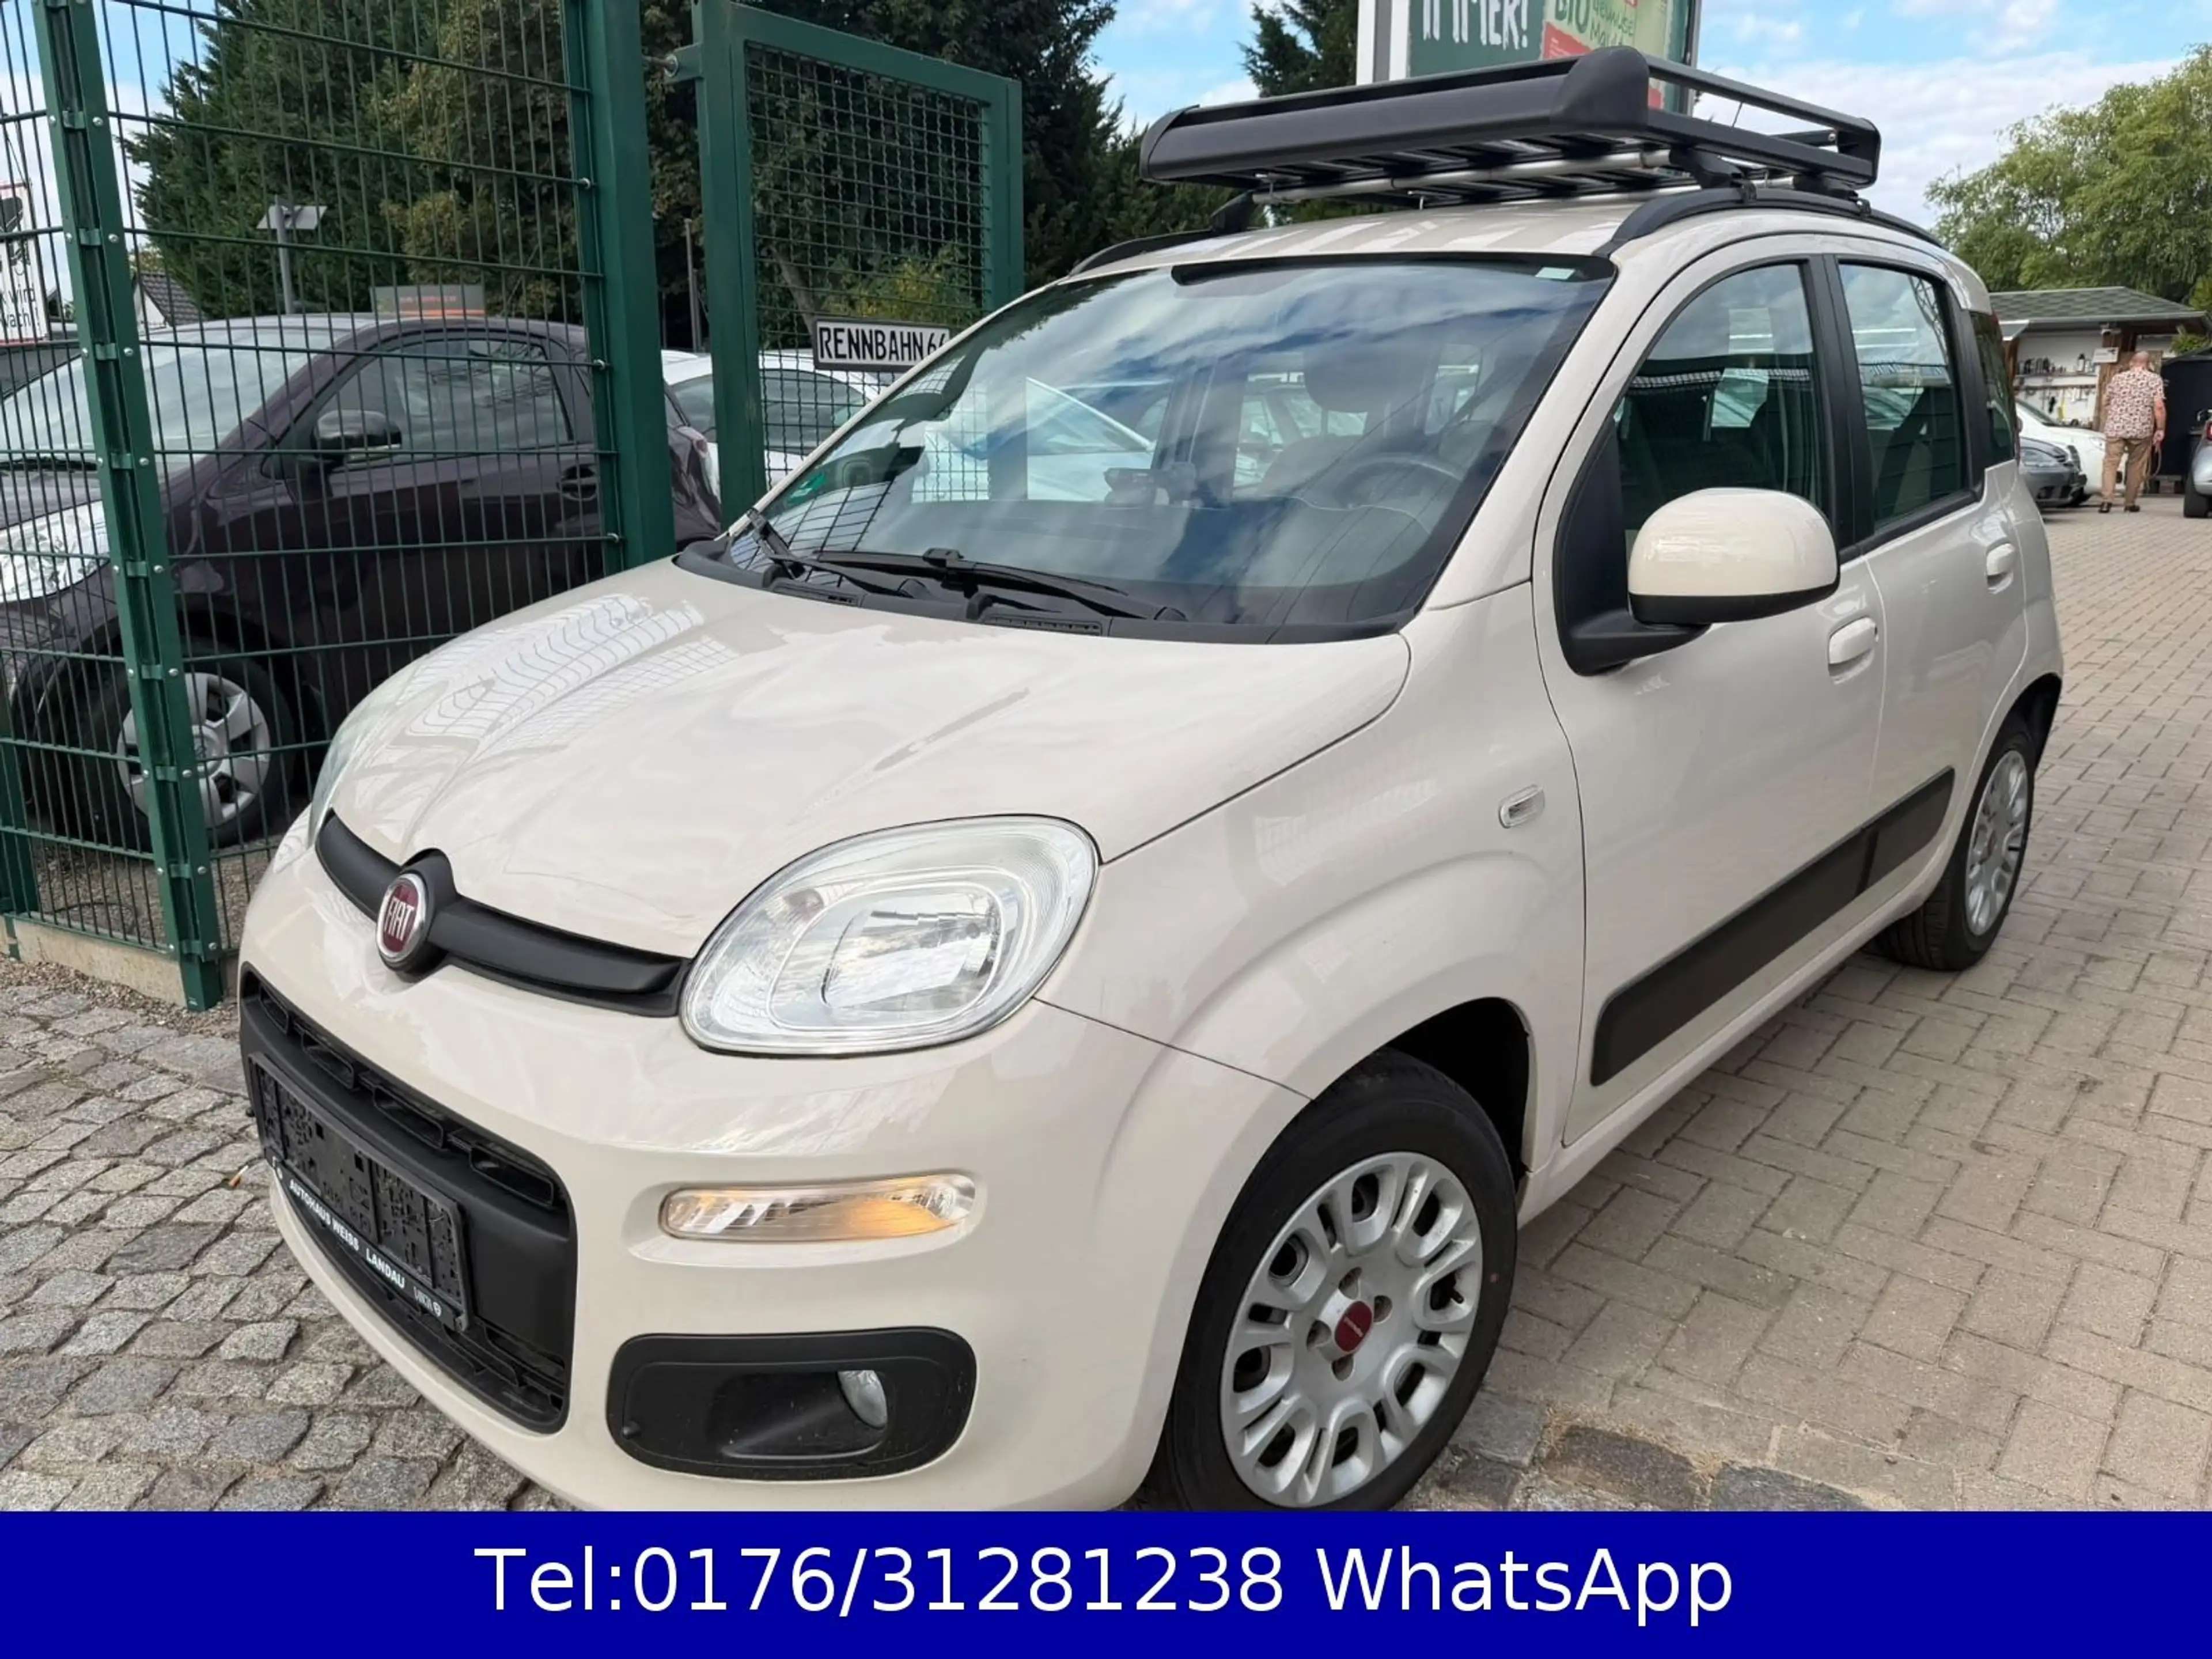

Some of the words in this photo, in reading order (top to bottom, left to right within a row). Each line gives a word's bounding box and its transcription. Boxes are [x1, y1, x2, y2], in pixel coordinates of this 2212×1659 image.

[819, 327, 923, 361] RENNBAHN
[384, 897, 415, 941] FIAT
[290, 1179, 331, 1226] AUTOHAUS
[366, 1248, 405, 1289] LANDAU
